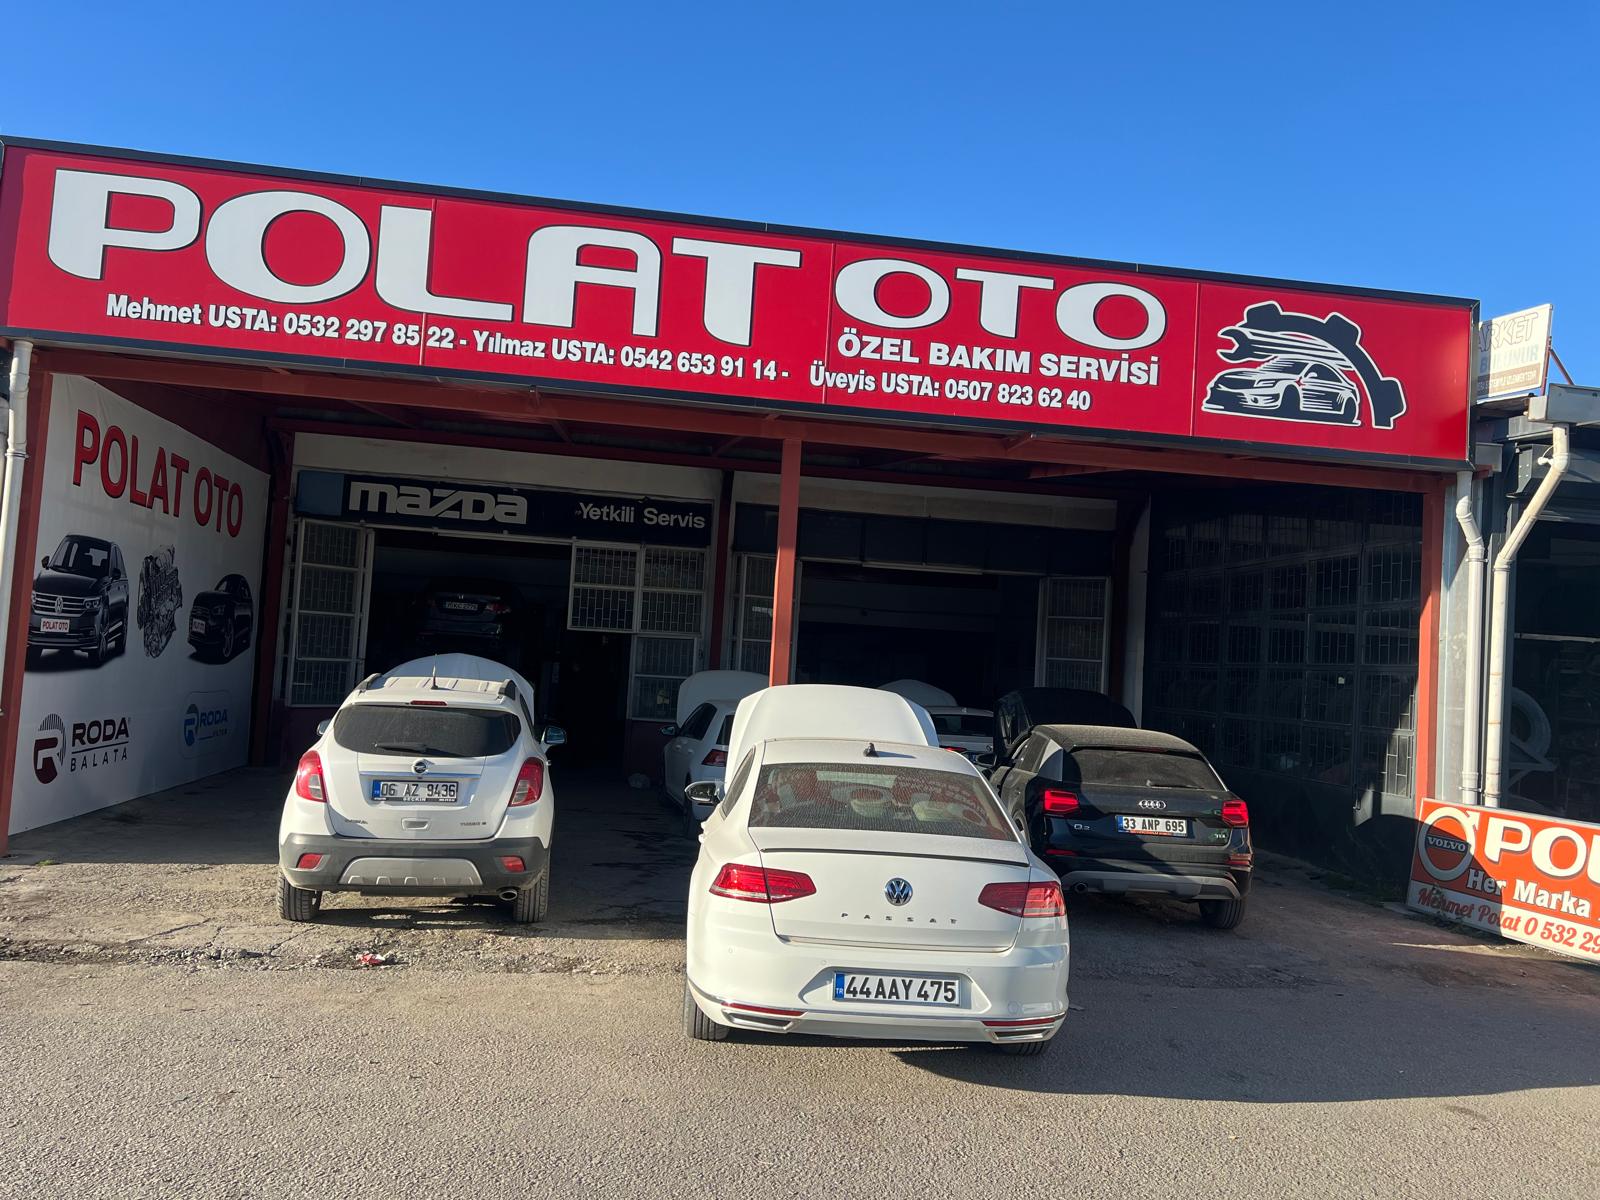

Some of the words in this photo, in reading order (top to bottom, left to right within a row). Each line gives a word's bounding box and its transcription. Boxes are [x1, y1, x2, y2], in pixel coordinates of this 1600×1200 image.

[47, 168, 801, 347] POLAT
[834, 257, 1167, 351] OTO
[106, 293, 202, 325] Mehmet
[208, 304, 277, 333] USTA:
[283, 312, 340, 339] 0532
[345, 318, 388, 343] 297
[391, 324, 420, 346] 85
[426, 326, 454, 349] 22
[472, 329, 546, 358] Yılmaz
[551, 338, 616, 366] USTA:
[620, 345, 673, 371] 0542
[676, 351, 716, 376] 653
[720, 356, 744, 378] 91
[837, 326, 920, 364] ÖZEL
[929, 342, 1031, 375] BAKIM
[1038, 352, 1160, 387] SERVİSİ
[809, 359, 876, 394] Üveyis
[881, 371, 940, 398] USTA:
[944, 378, 993, 402] 0507
[998, 383, 1034, 407] 823
[1038, 386, 1063, 409] 62
[1066, 390, 1092, 412] 40
[72, 408, 190, 519] POLAT
[193, 466, 243, 538] OTO
[348, 481, 528, 525] mazda
[579, 502, 635, 523] Yetkili
[643, 507, 706, 529] Servis
[71, 716, 130, 748] RODA
[199, 708, 229, 729] RODA
[70, 746, 128, 773] BALATA
[381, 783, 396, 797] 06
[404, 783, 419, 797] AZ
[426, 783, 456, 798] 9436
[1123, 817, 1137, 830] 33
[1141, 818, 1161, 831] ANP
[1165, 820, 1185, 833] 695
[1426, 836, 1467, 852] VOLVO
[1485, 816, 1600, 884] PO
[1466, 867, 1507, 897] Her
[1512, 878, 1591, 919] Marka
[841, 912, 957, 925] PASSAT
[1478, 904, 1521, 932] Polat
[1523, 916, 1539, 936] 0
[1540, 921, 1578, 948] 532
[836, 986, 844, 996] TR
[845, 976, 872, 999] 44
[874, 977, 914, 1001] AAY
[916, 979, 957, 1003] 475
